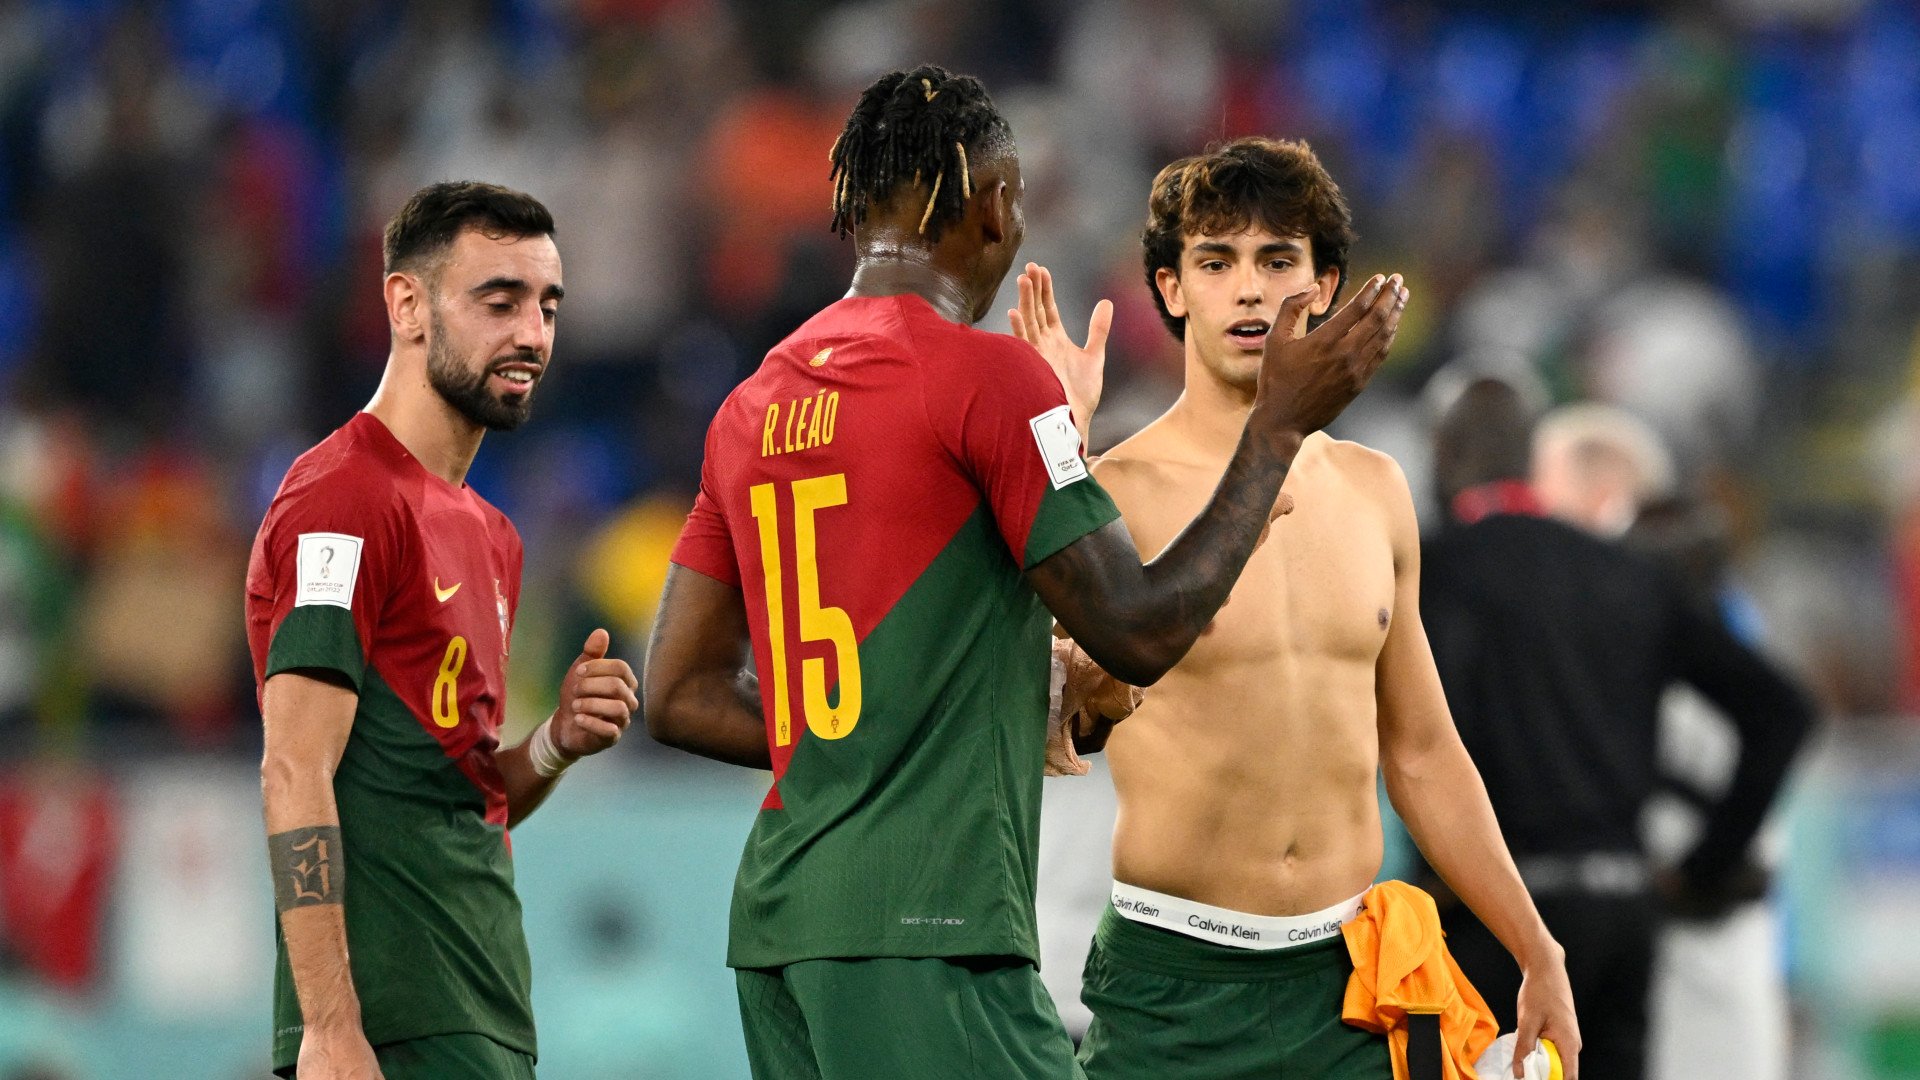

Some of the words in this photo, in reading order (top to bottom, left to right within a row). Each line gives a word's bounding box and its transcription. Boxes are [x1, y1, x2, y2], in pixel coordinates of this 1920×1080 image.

[750, 473, 862, 747] 15
[432, 635, 468, 729] 8
[1132, 900, 1160, 918] Klein
[1187, 914, 1228, 935] Calvin
[1231, 924, 1260, 941] Klein
[1287, 925, 1321, 941] Calvin
[1323, 917, 1343, 935] Klein
